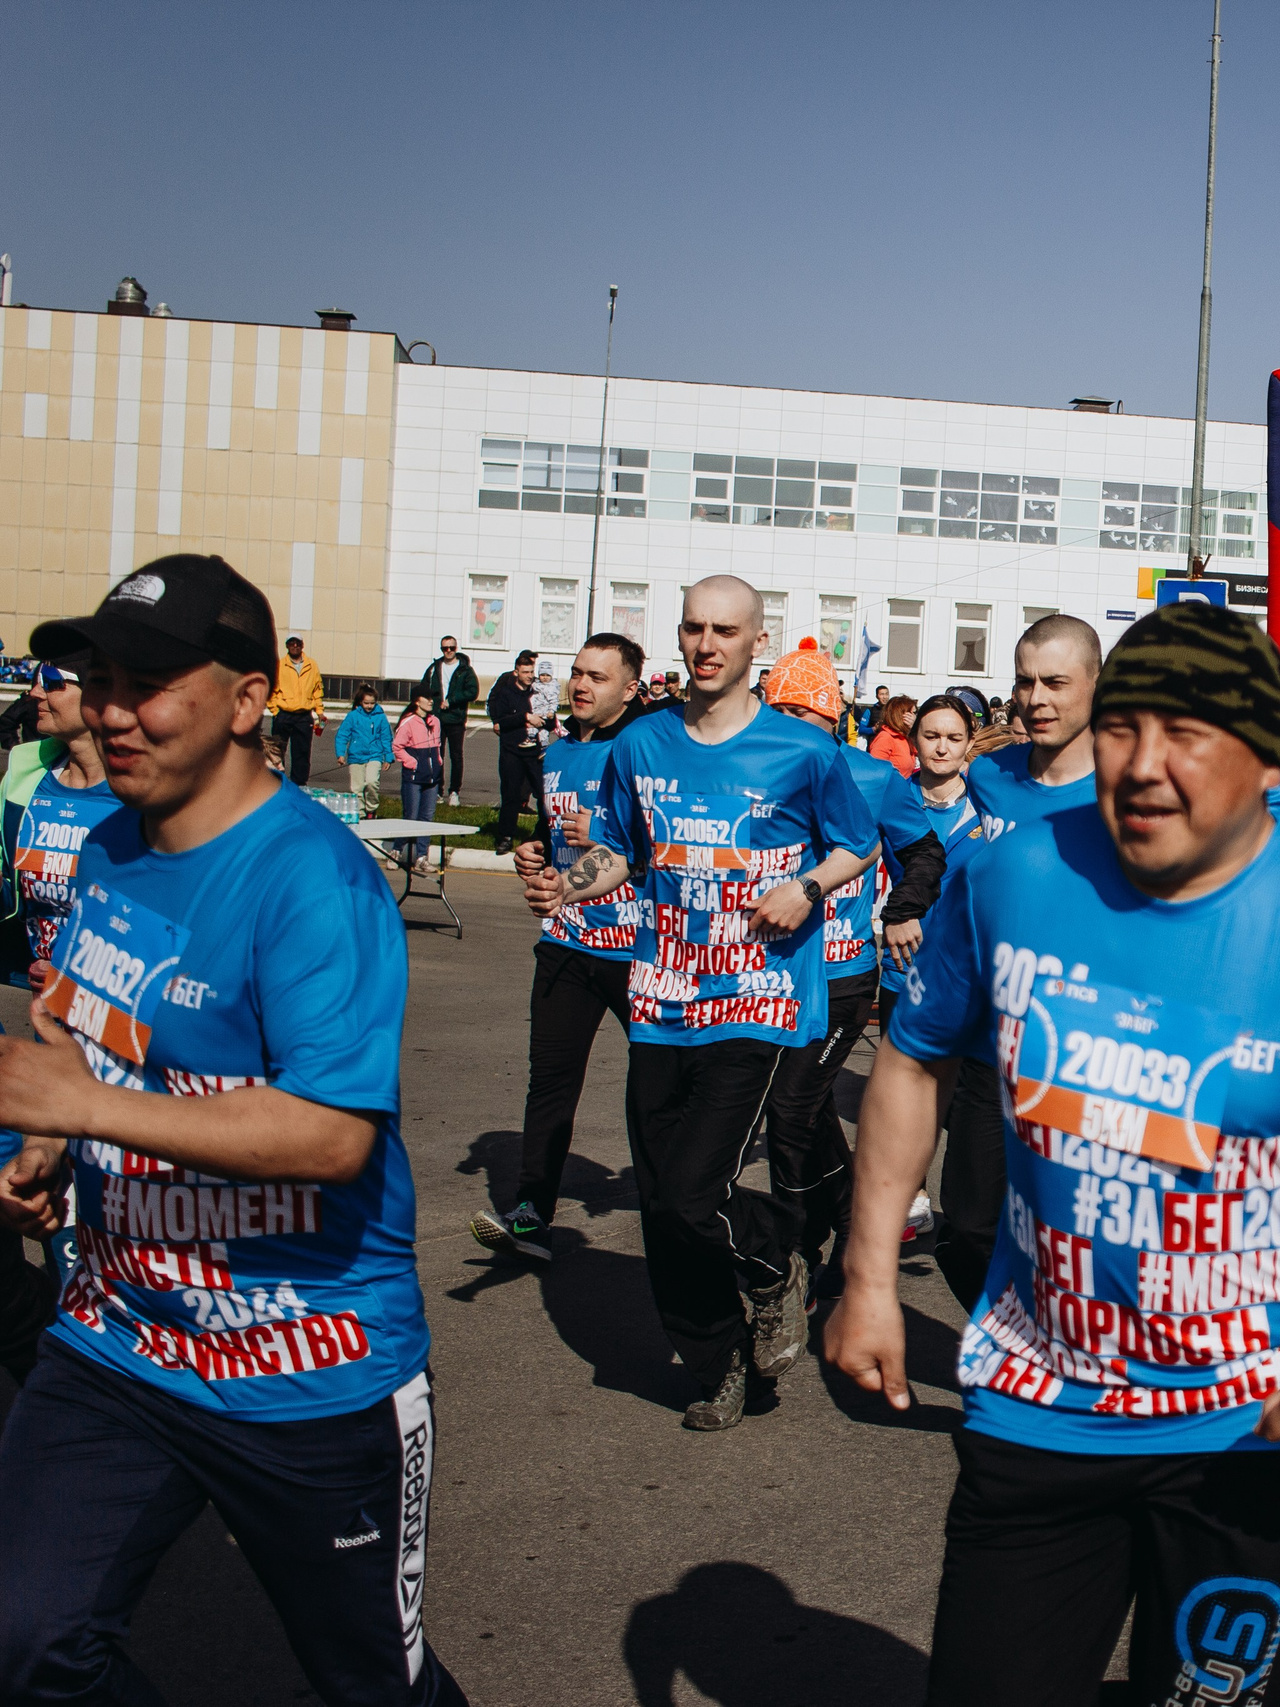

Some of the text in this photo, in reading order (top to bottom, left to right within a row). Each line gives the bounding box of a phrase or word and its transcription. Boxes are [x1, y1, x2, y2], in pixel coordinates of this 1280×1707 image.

[752, 803, 777, 818] БЕГ
[672, 817, 731, 845] 20052
[615, 901, 640, 926] 20
[578, 922, 638, 950] #ЕДИН
[825, 919, 854, 942] 024
[70, 928, 145, 1007] 20032
[164, 974, 209, 1010] БЕГ
[737, 969, 795, 997] 2024
[1059, 1030, 1191, 1109] 20033
[102, 1174, 323, 1242] #МОМЕНТ
[182, 1280, 309, 1333] 2024
[403, 1420, 430, 1570] Reebok
[334, 1529, 382, 1549] Reebok
